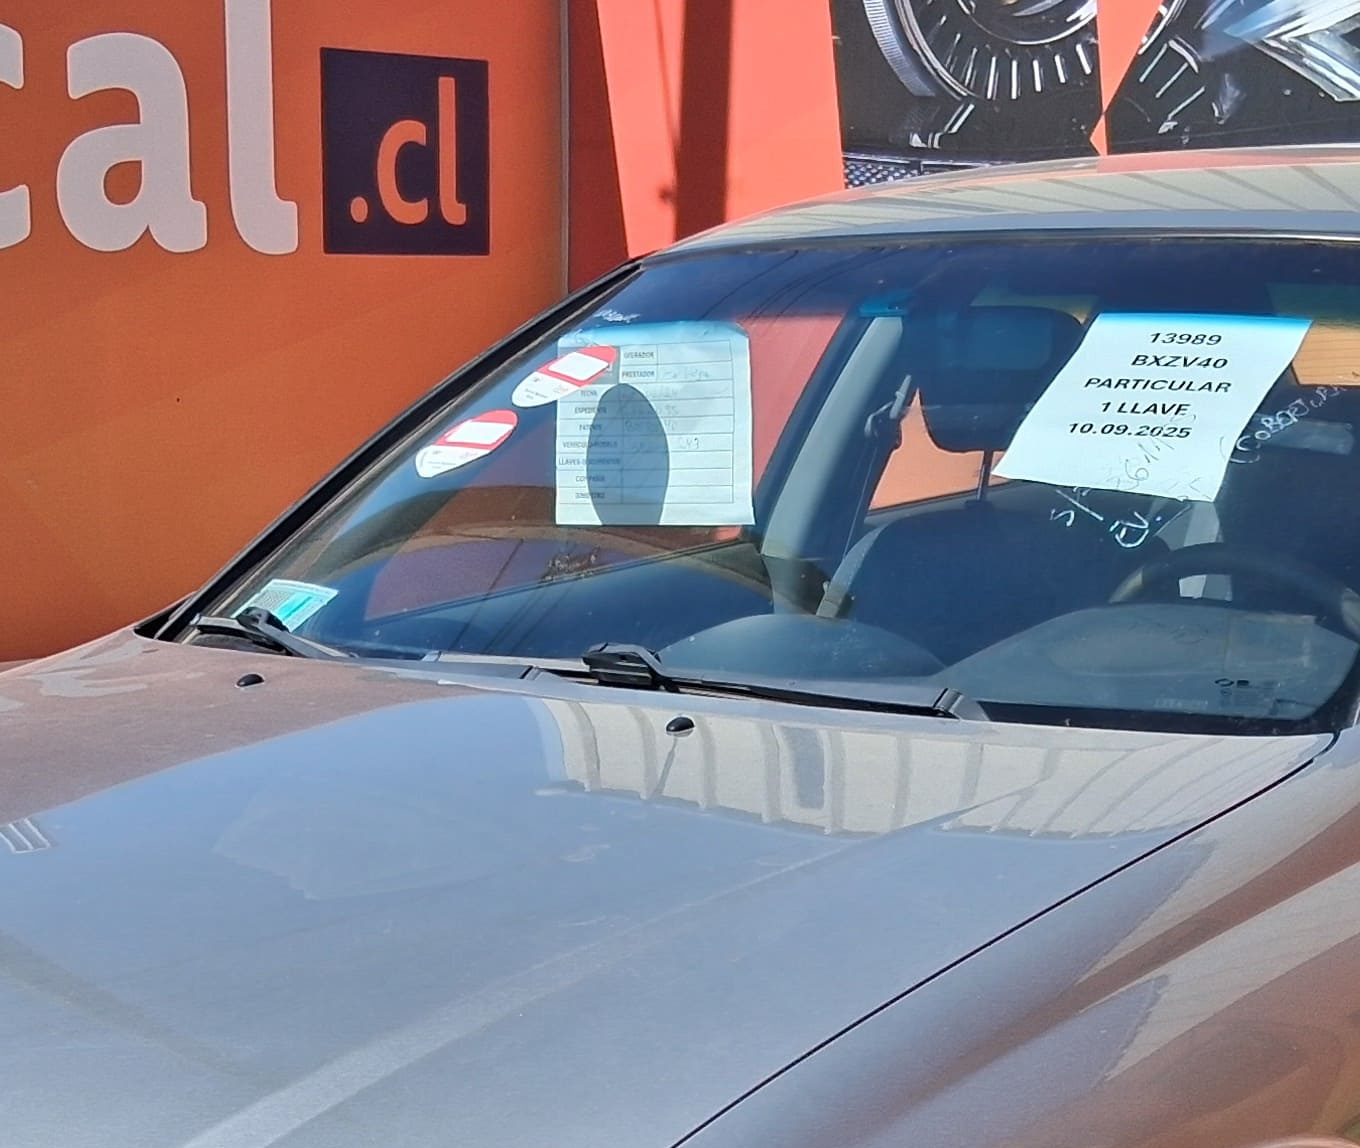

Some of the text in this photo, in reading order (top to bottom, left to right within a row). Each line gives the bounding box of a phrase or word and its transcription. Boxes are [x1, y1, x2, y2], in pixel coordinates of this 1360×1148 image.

[350, 77, 468, 226] .cl
[1150, 332, 1223, 346] 13989
[1131, 354, 1228, 370] BXZV40
[1084, 377, 1232, 393] PARTICULAR
[1101, 400, 1191, 416] 1 LLAVE
[1069, 422, 1192, 439] 10.09.2025
